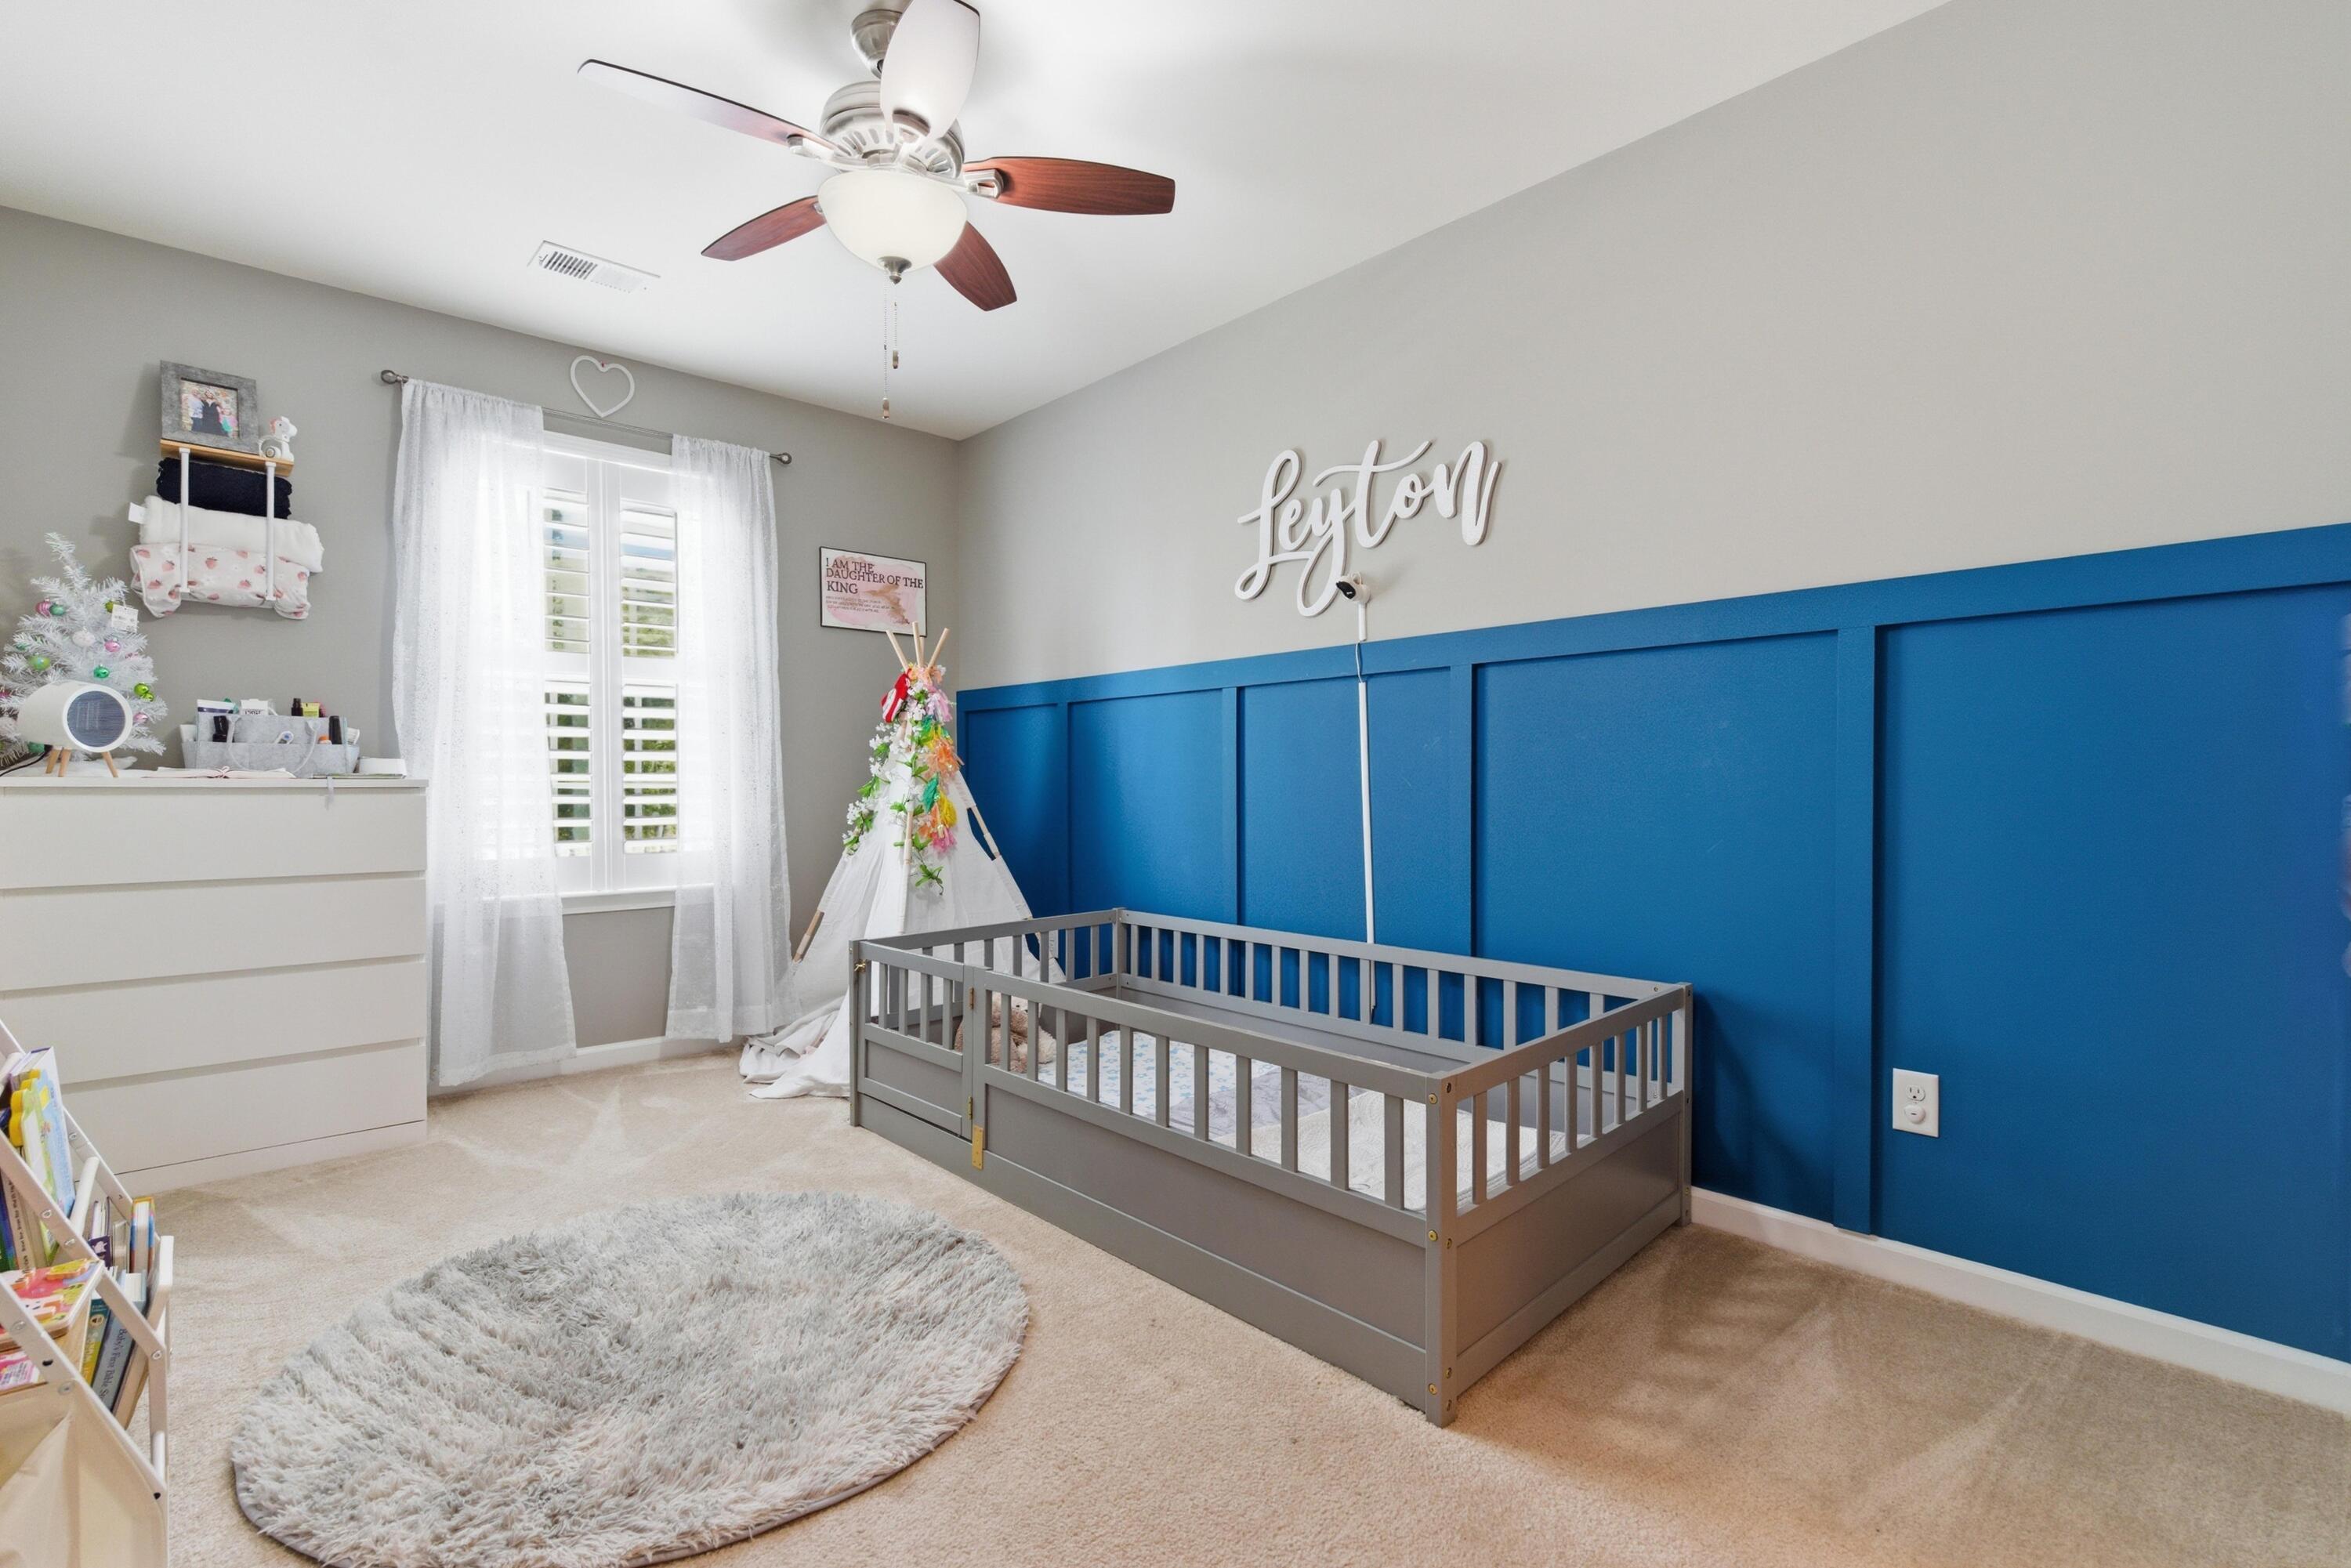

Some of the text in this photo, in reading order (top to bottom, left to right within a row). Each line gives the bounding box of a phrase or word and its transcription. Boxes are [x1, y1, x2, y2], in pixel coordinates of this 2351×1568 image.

[1234, 440, 1500, 617] Leyton
[826, 557, 875, 574] I AM THE
[826, 567, 924, 588] DAUGHTER OF THE
[827, 581, 858, 594] KING
